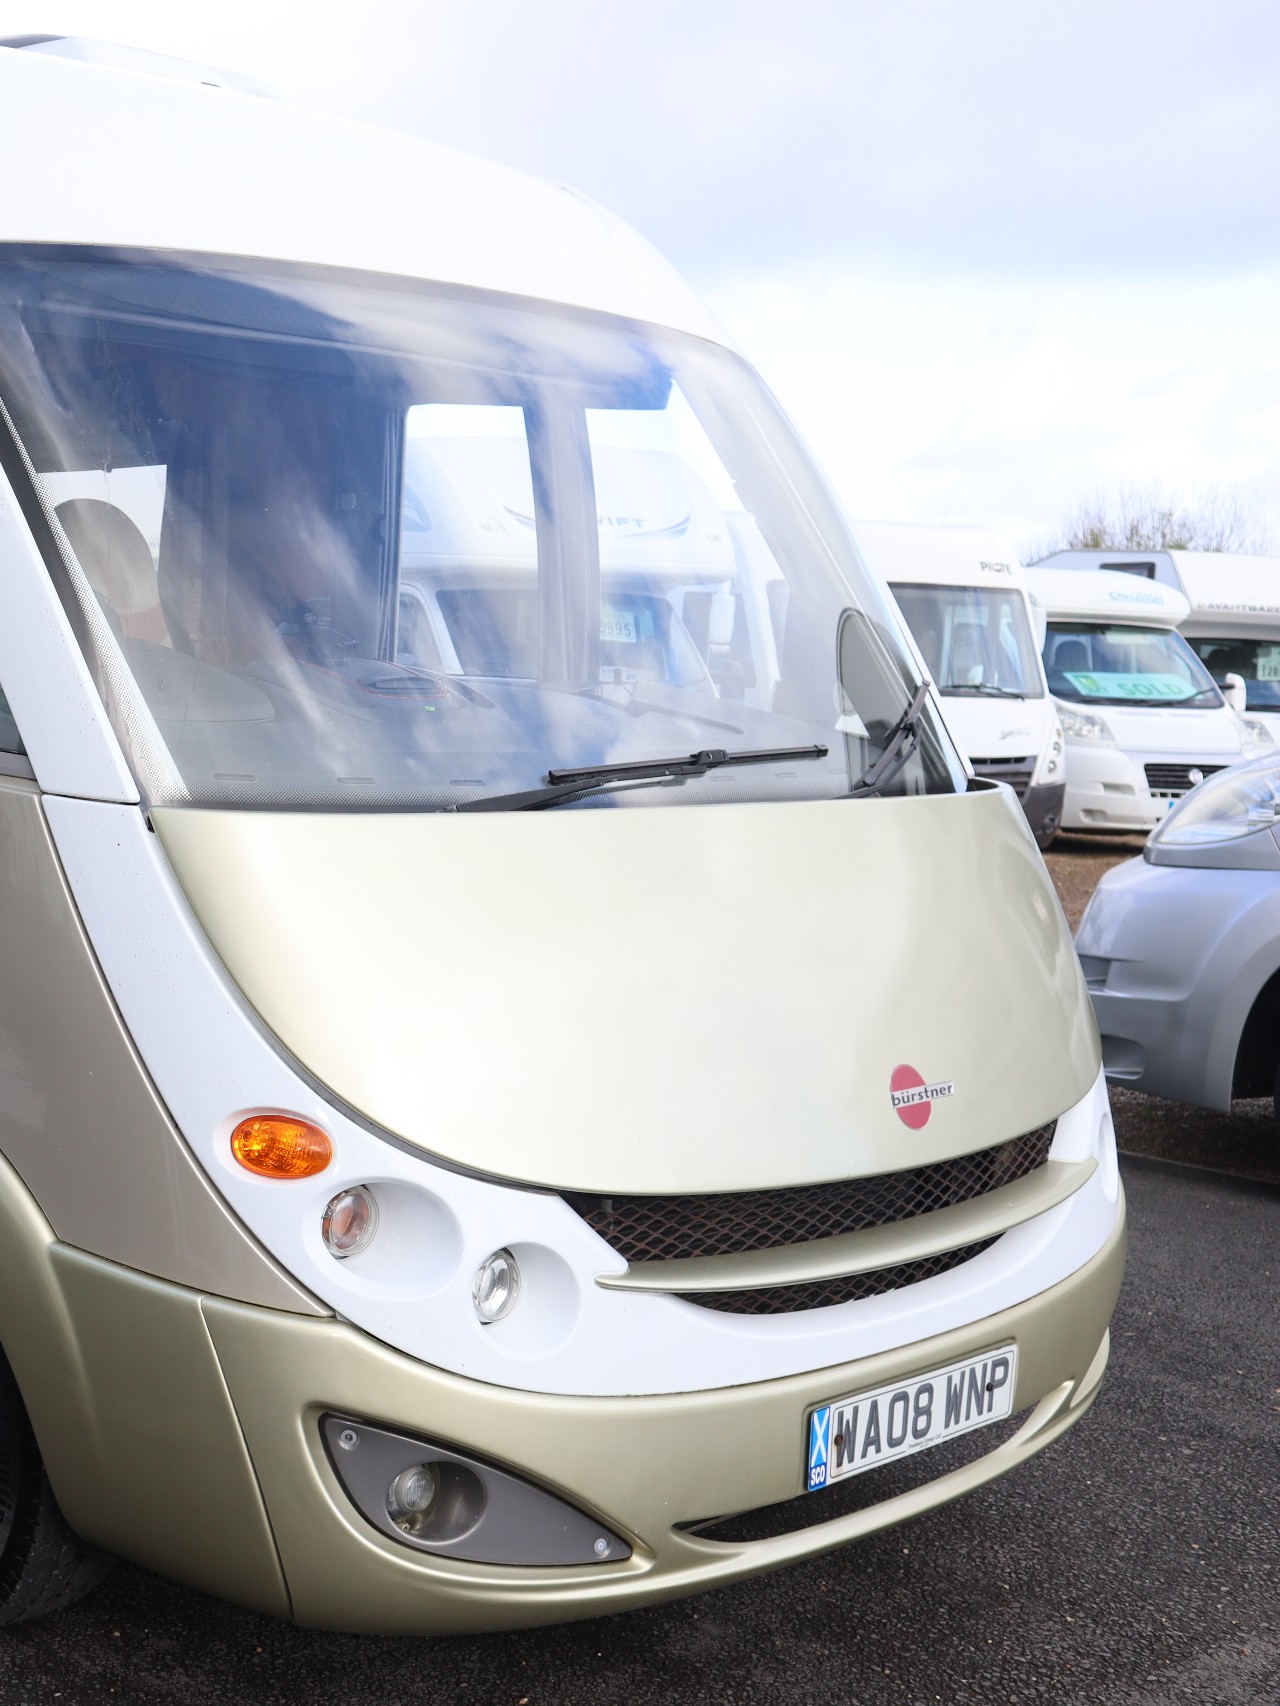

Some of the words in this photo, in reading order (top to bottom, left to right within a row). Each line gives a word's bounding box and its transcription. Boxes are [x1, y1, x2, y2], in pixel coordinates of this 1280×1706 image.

[1117, 682, 1184, 697] SOLD
[891, 1084, 953, 1107] bürstner
[835, 1382, 935, 1469] WA08
[943, 1355, 1010, 1430] WNP
[810, 1466, 826, 1487] SCO
